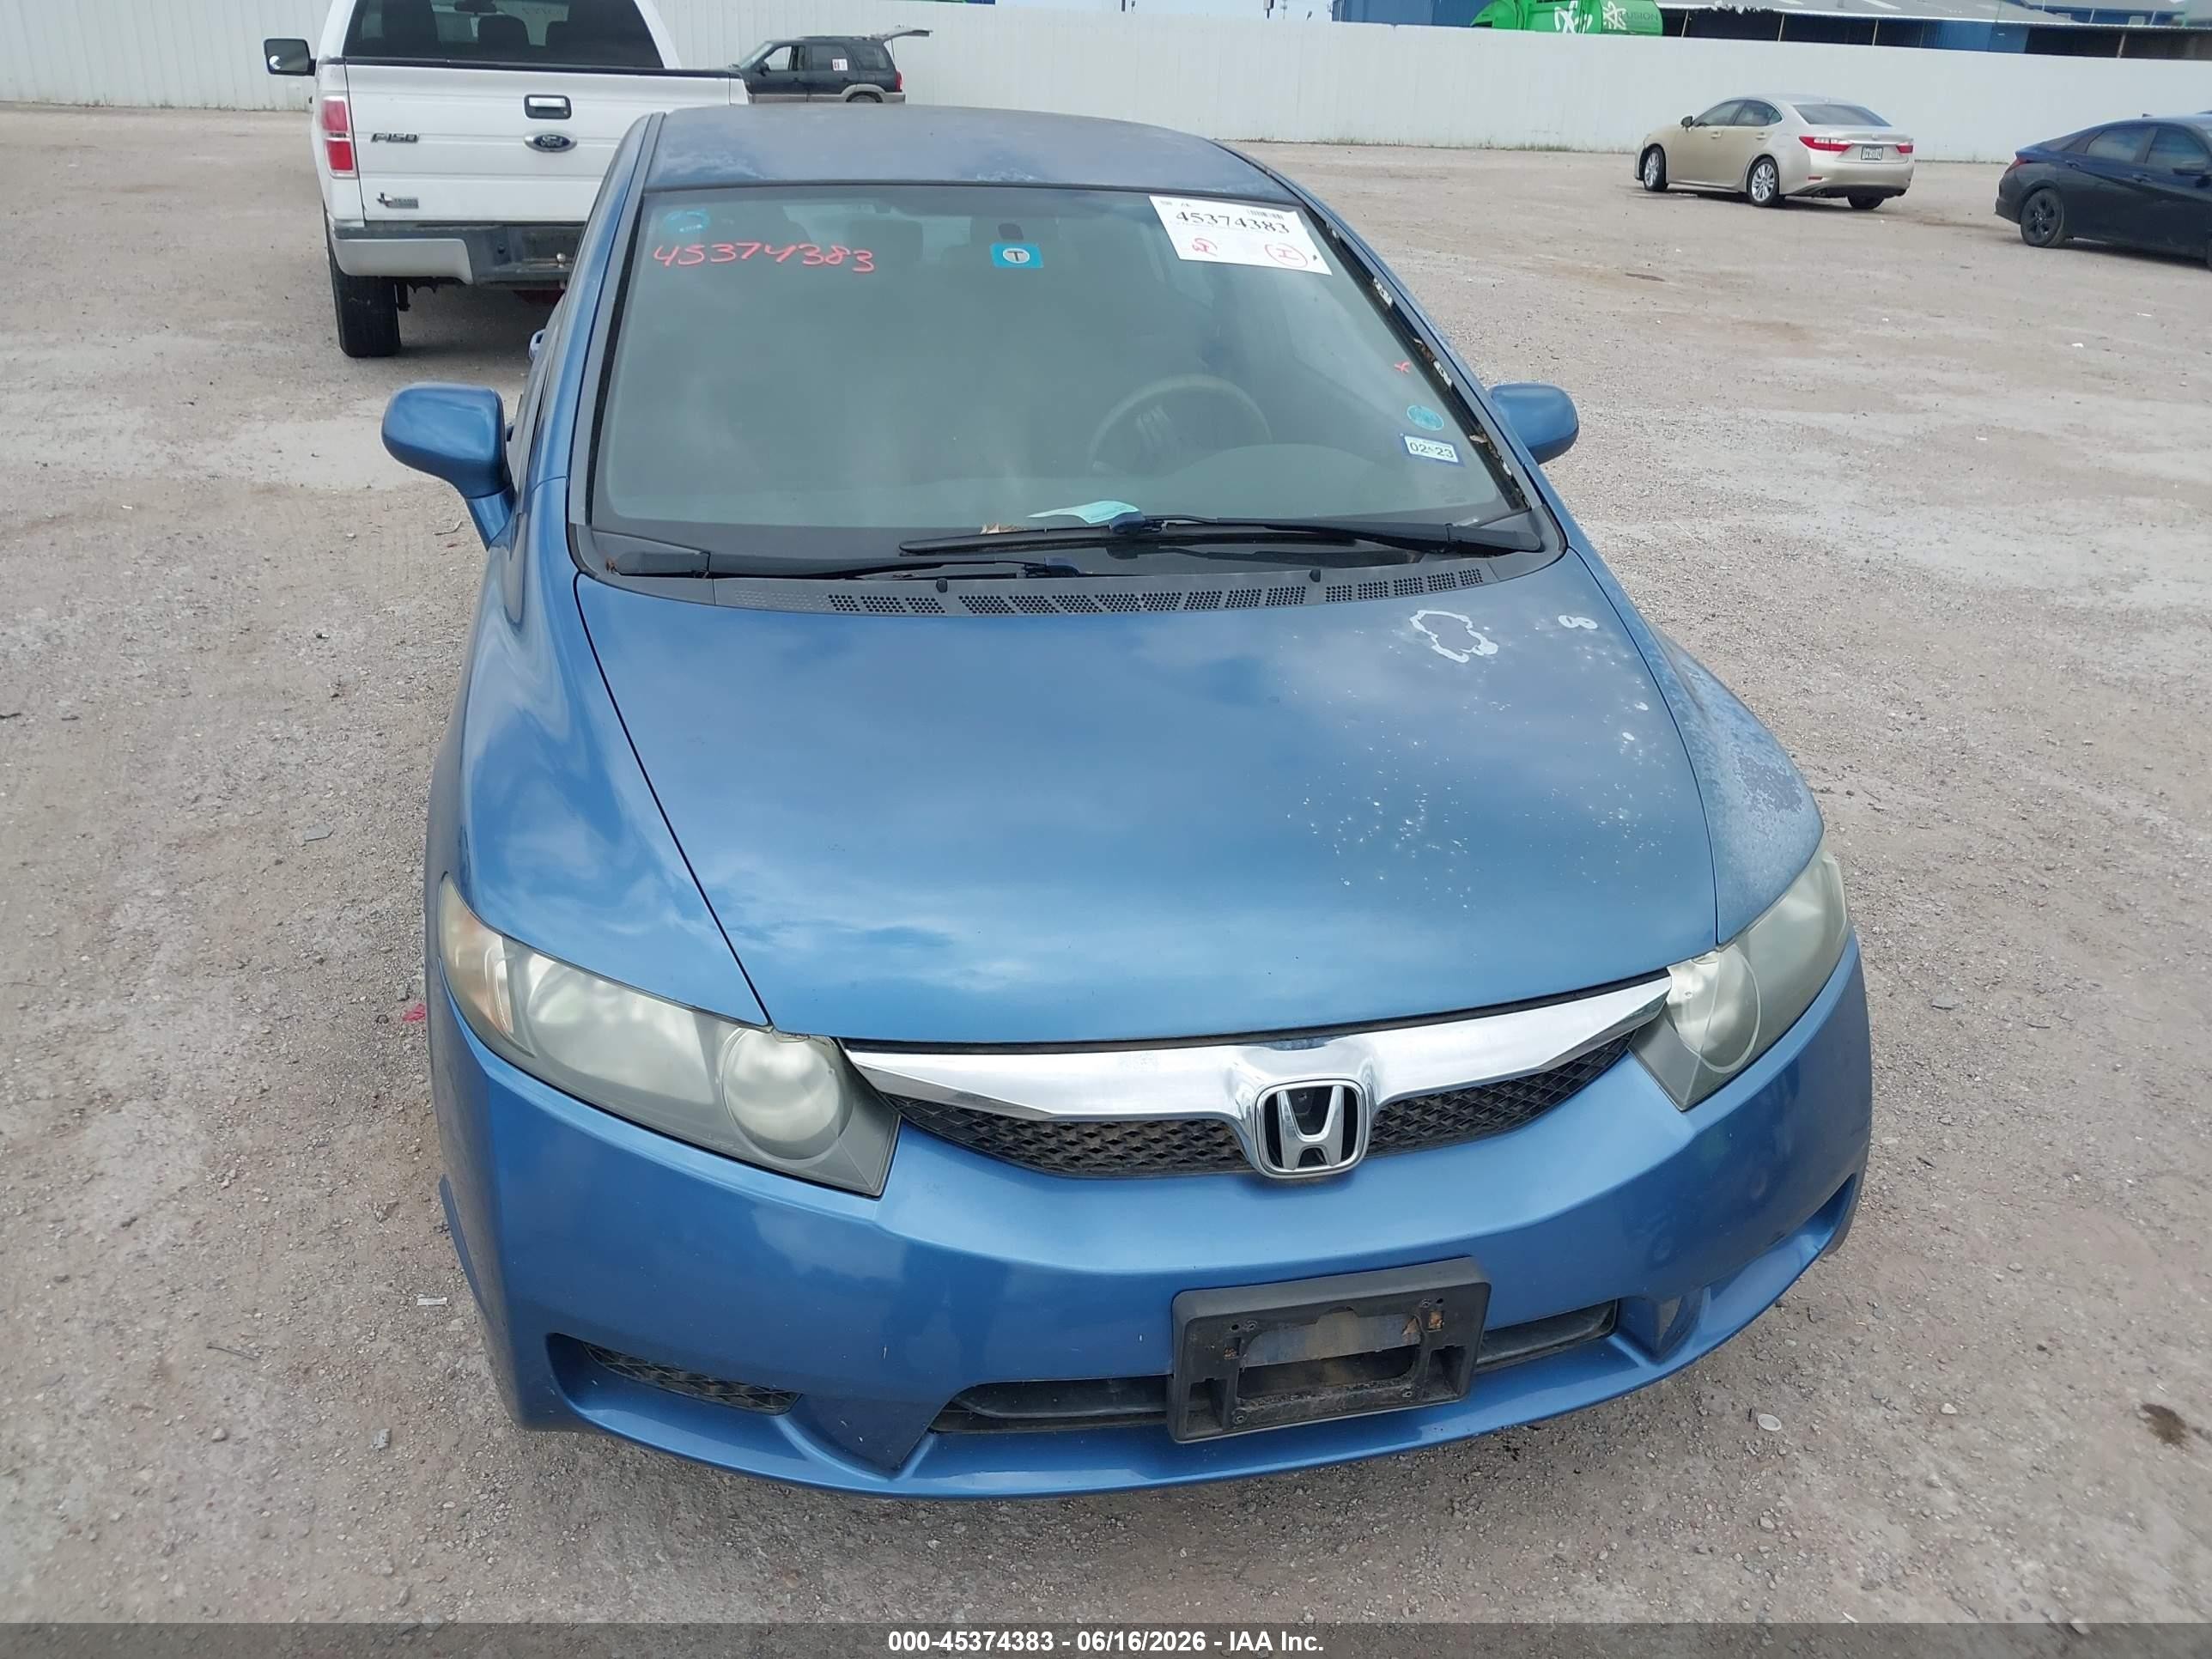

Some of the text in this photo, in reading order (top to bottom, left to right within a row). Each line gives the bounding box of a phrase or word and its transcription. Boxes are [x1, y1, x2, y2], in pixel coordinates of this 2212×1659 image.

[1176, 210, 1290, 234] 45374383
[653, 241, 876, 272] 45374383
[1006, 250, 1024, 263] T
